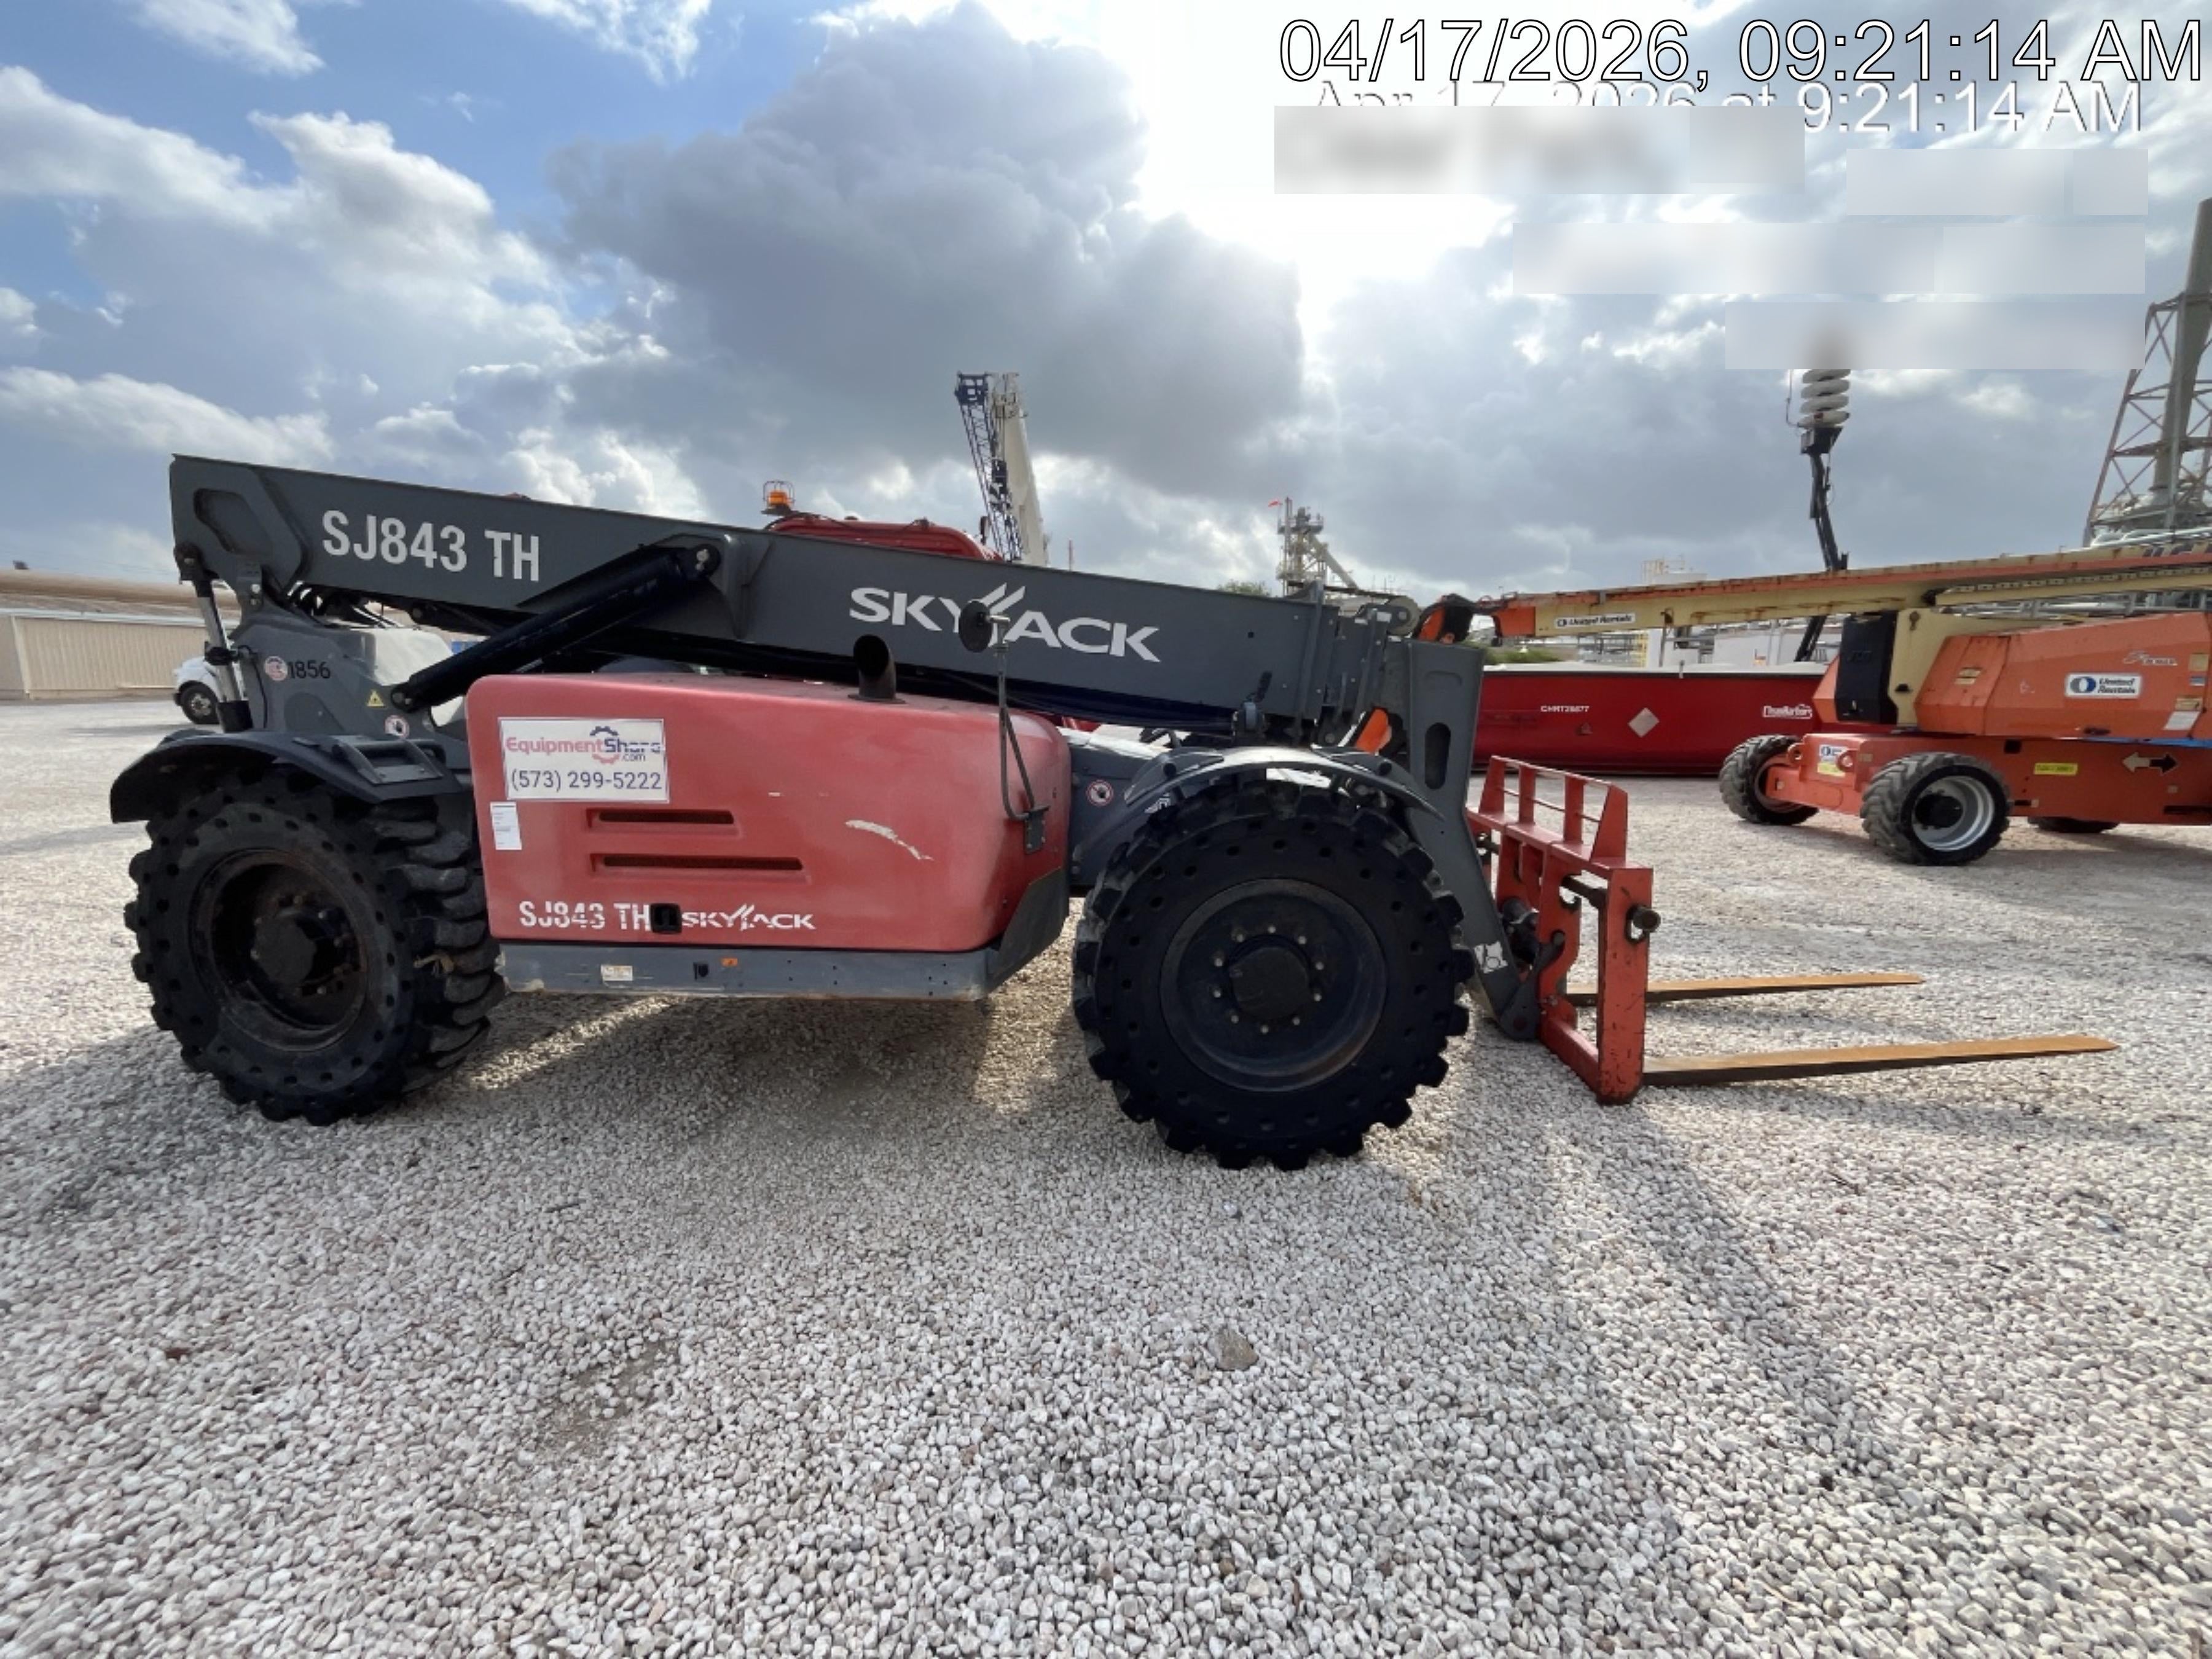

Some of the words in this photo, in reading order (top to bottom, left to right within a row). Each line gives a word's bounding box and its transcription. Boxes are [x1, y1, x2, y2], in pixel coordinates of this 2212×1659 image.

[322, 509, 468, 572] SJ843
[484, 529, 539, 582] TH
[287, 659, 331, 679] 1856
[511, 769, 562, 792] (573)
[567, 771, 662, 790] 299-5222
[614, 903, 651, 931] TH
[681, 903, 816, 931] SKYJACK
